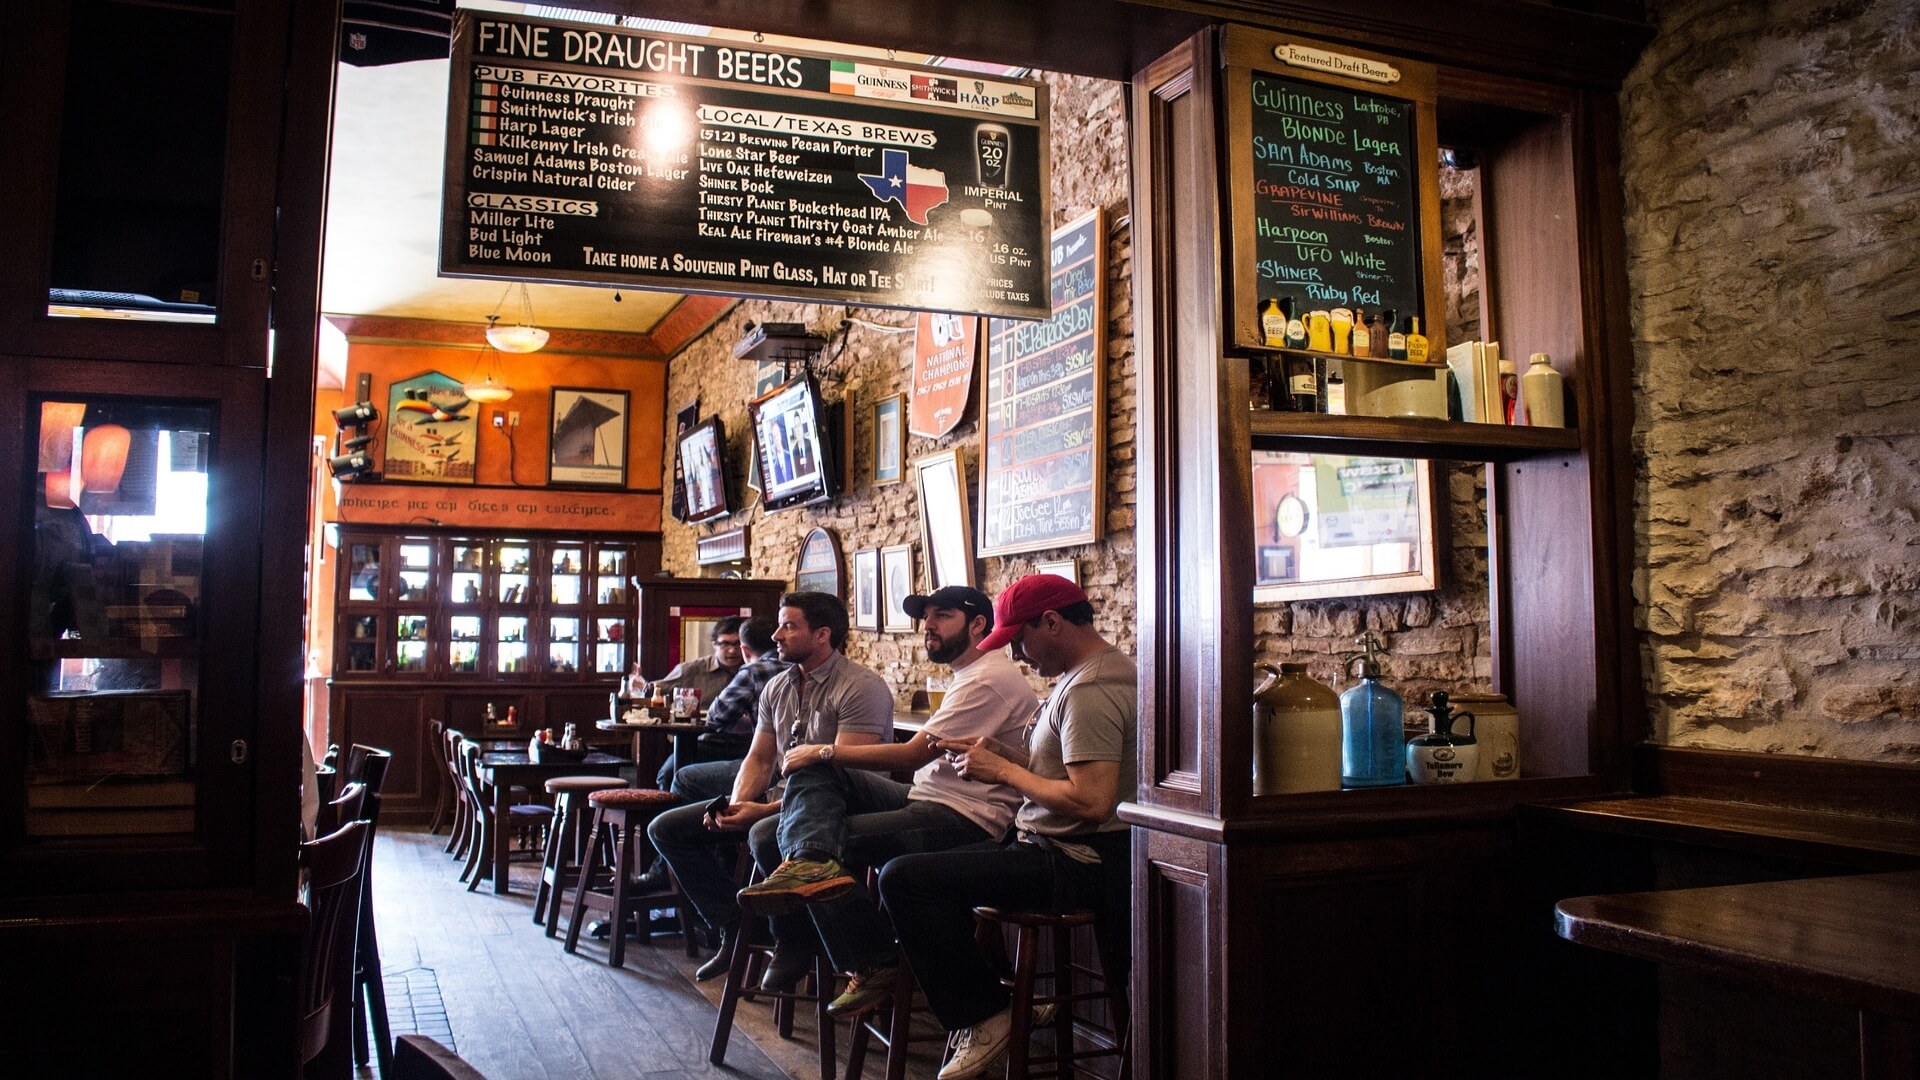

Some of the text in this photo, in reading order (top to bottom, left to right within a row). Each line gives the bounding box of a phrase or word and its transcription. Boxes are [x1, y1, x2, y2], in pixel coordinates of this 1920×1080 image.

[479, 21, 802, 88] FINE DRAUGHT BEERS
[1288, 48, 1389, 79] Featured Draft Beers
[477, 67, 674, 98] PUB FAVORITES
[857, 75, 908, 90] GUINNESS
[911, 84, 956, 96] SMITHWICK'S
[501, 85, 636, 112] Guinness Draught
[960, 93, 1000, 107] HARP
[1252, 79, 1345, 120] Guinness
[501, 101, 597, 124] Smithwick's
[601, 112, 636, 128] Irish
[500, 117, 586, 143] Harp Lager
[701, 108, 933, 147] LOCAL/TEXAS BREWS
[499, 134, 569, 155] Kilkenny
[573, 140, 610, 158] Irish
[700, 128, 736, 143] (512)
[792, 136, 831, 152] Pecan
[834, 141, 875, 159] Porter
[700, 143, 800, 166] Lone Star Beer
[982, 146, 1004, 160] 20
[1253, 136, 1294, 164] SAM
[473, 148, 689, 182] Samuel Adams Boston Lager
[754, 165, 833, 185] Hefeweizen
[472, 165, 636, 192] Crispin Natural Cider
[741, 178, 775, 195] Bock
[1288, 170, 1320, 188] Cold
[1377, 174, 1391, 186] MA
[965, 185, 1023, 202] IMPERIAL
[1256, 179, 1344, 207] GRAPEVINE
[470, 194, 593, 217] CLASSICS
[789, 199, 867, 221] Buckethead
[871, 206, 891, 221] IPA
[471, 211, 555, 231] Miller Lite
[789, 215, 840, 238] Thirsty
[842, 220, 874, 237] Goat
[878, 224, 921, 241] Amber
[924, 227, 944, 242] Ale
[1257, 217, 1329, 244] Harpoon
[470, 227, 544, 247] Bud Light
[756, 228, 822, 248] Fireman's
[825, 234, 845, 248] #4
[848, 236, 890, 253] Blonde
[893, 239, 914, 255] Ale
[969, 231, 985, 244] 16
[1363, 234, 1394, 247] Boston
[469, 244, 552, 264] Blue Moon
[993, 242, 1009, 255] 16
[1297, 245, 1387, 272] UFO White
[990, 254, 1006, 266] US
[986, 278, 1014, 290] PRICES
[1305, 284, 1381, 306] Ruby Red
[1007, 291, 1031, 304] TAXES
[926, 345, 967, 368] NATIONAL
[922, 357, 970, 382] CHAMPIONS
[1425, 761, 1463, 771] Tullamore
[1437, 770, 1454, 779] Dew
